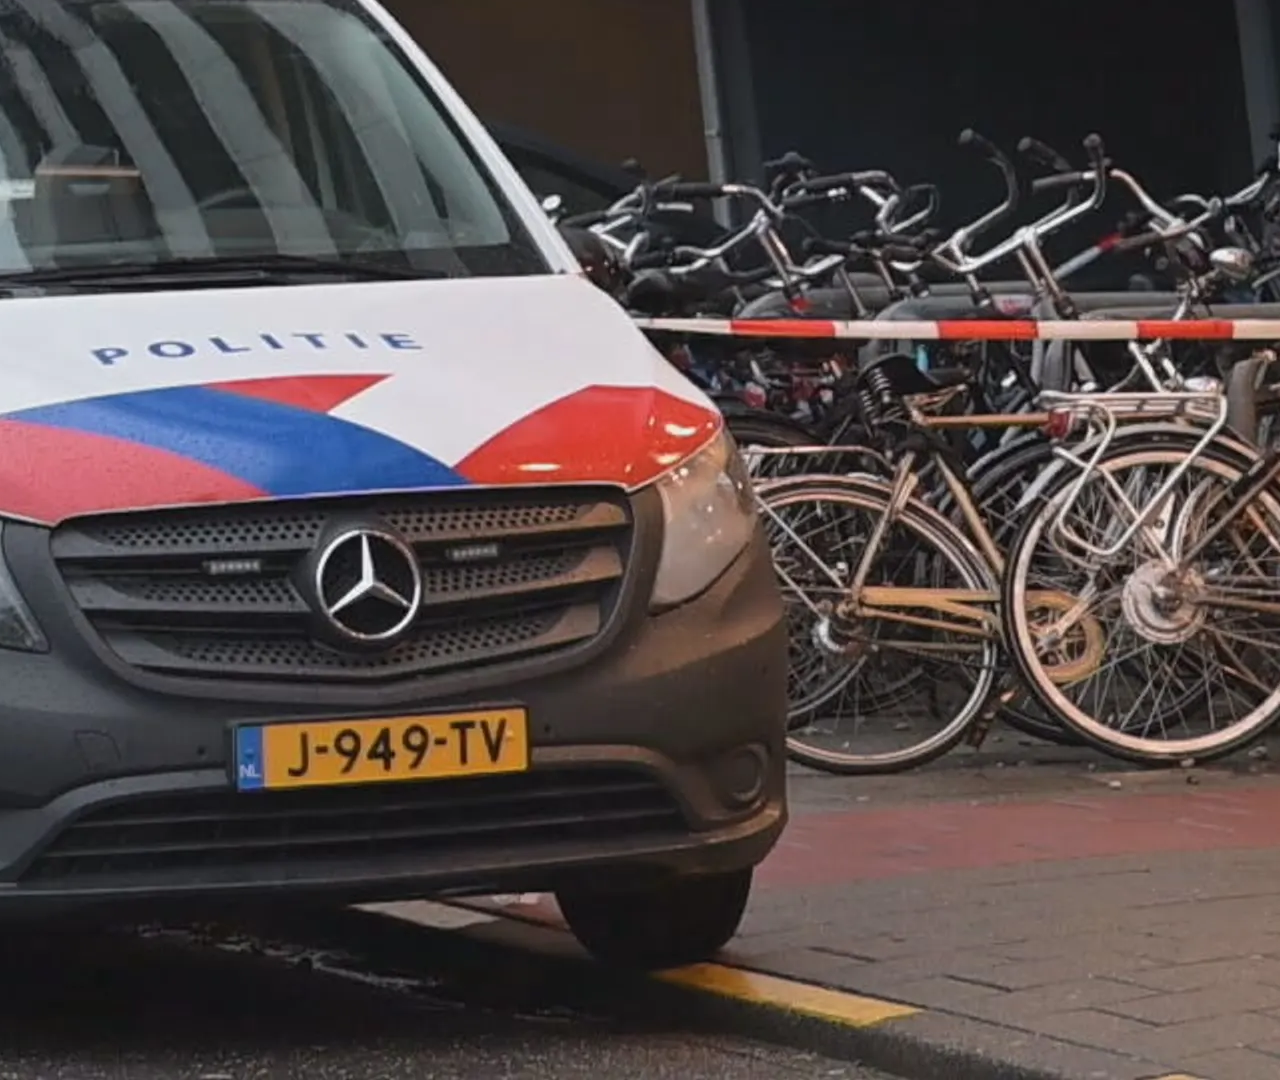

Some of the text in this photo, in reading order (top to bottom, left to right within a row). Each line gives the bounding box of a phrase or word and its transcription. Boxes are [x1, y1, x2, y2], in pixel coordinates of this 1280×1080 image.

[91, 332, 424, 365] POLITIE
[287, 718, 508, 777] J-949-TV
[239, 764, 261, 778] NL
